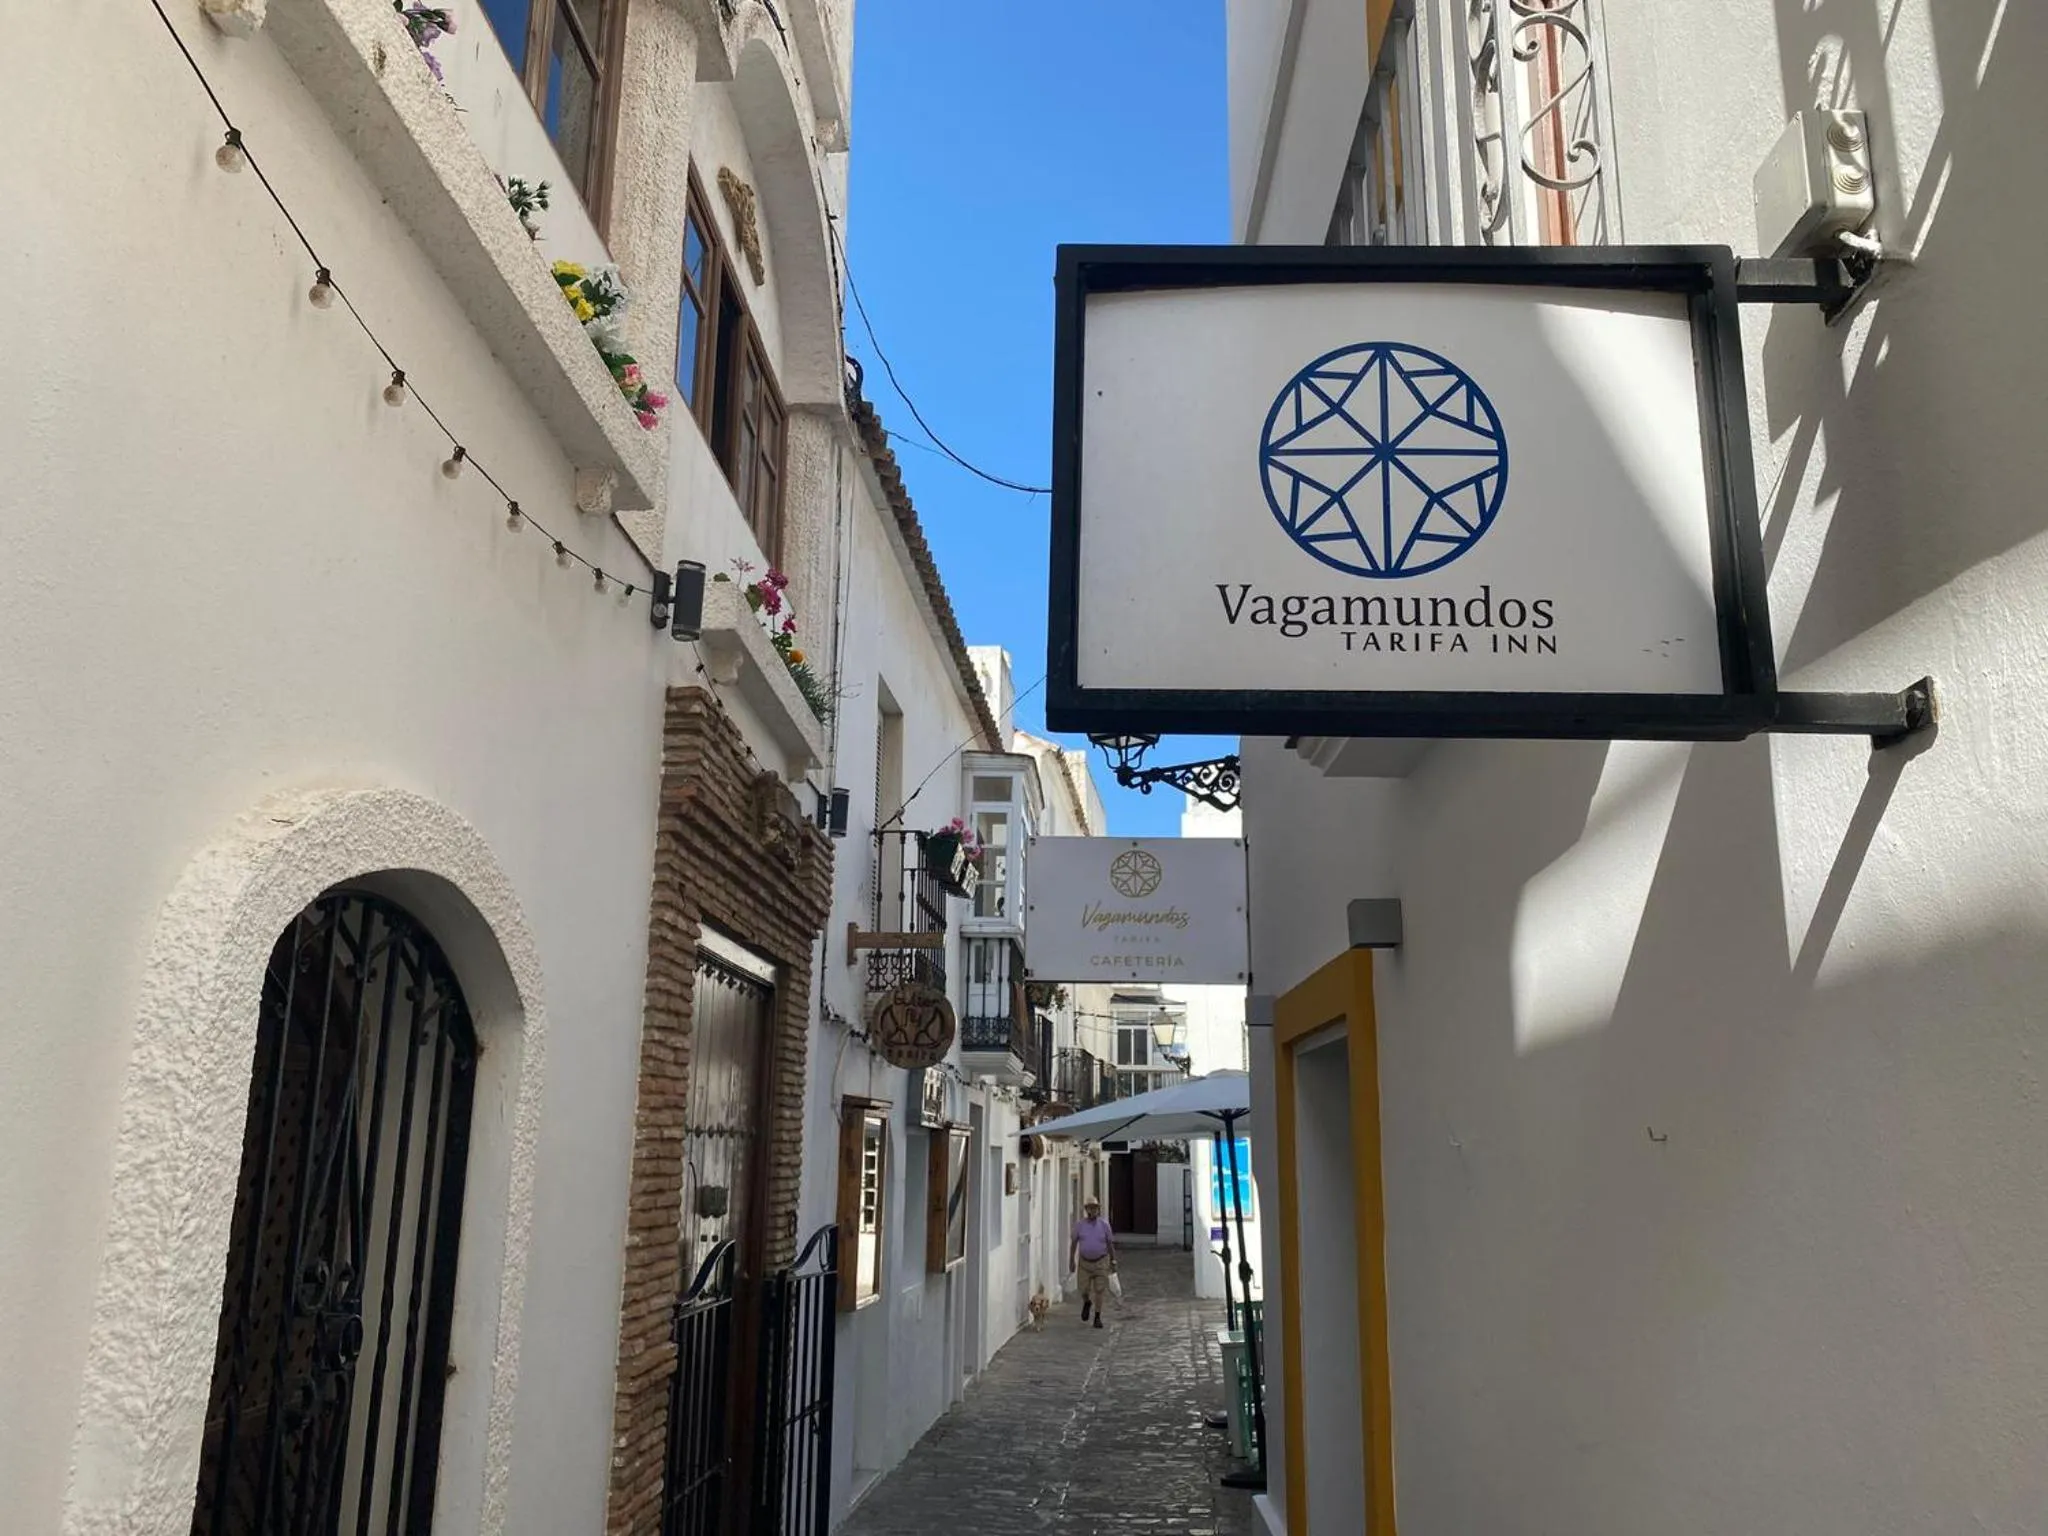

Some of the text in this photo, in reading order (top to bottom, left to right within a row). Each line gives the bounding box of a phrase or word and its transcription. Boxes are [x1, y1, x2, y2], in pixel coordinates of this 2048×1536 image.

[1215, 583, 1556, 638] Vagamundos
[1340, 631, 1557, 655] TARIFA INN
[1081, 900, 1190, 931] Vagamundos
